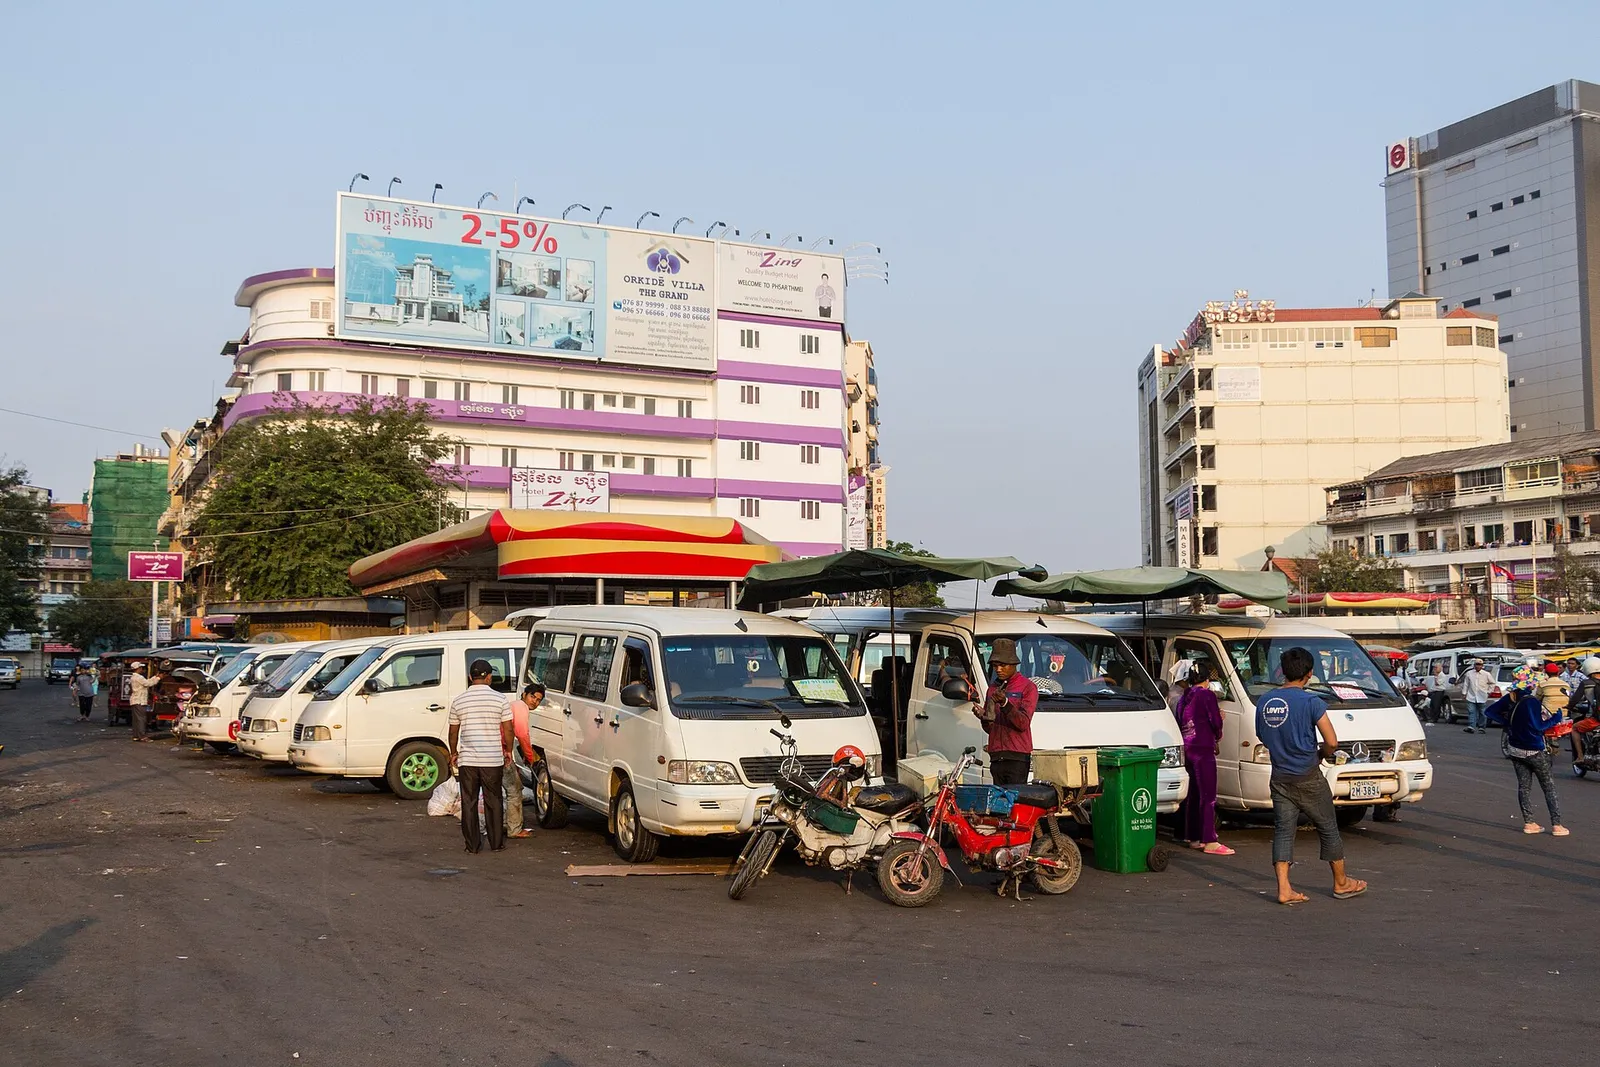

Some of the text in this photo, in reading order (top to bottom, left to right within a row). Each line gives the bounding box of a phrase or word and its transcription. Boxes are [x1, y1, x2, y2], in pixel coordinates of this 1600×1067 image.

[461, 214, 558, 254] 2-5%
[760, 252, 803, 268] Zing
[745, 267, 764, 276] Quality
[765, 270, 783, 279] Budget
[671, 280, 705, 291] VILLA
[737, 279, 762, 288] WELCOME
[639, 288, 689, 301] THE GRAND
[542, 491, 601, 507] Zing
